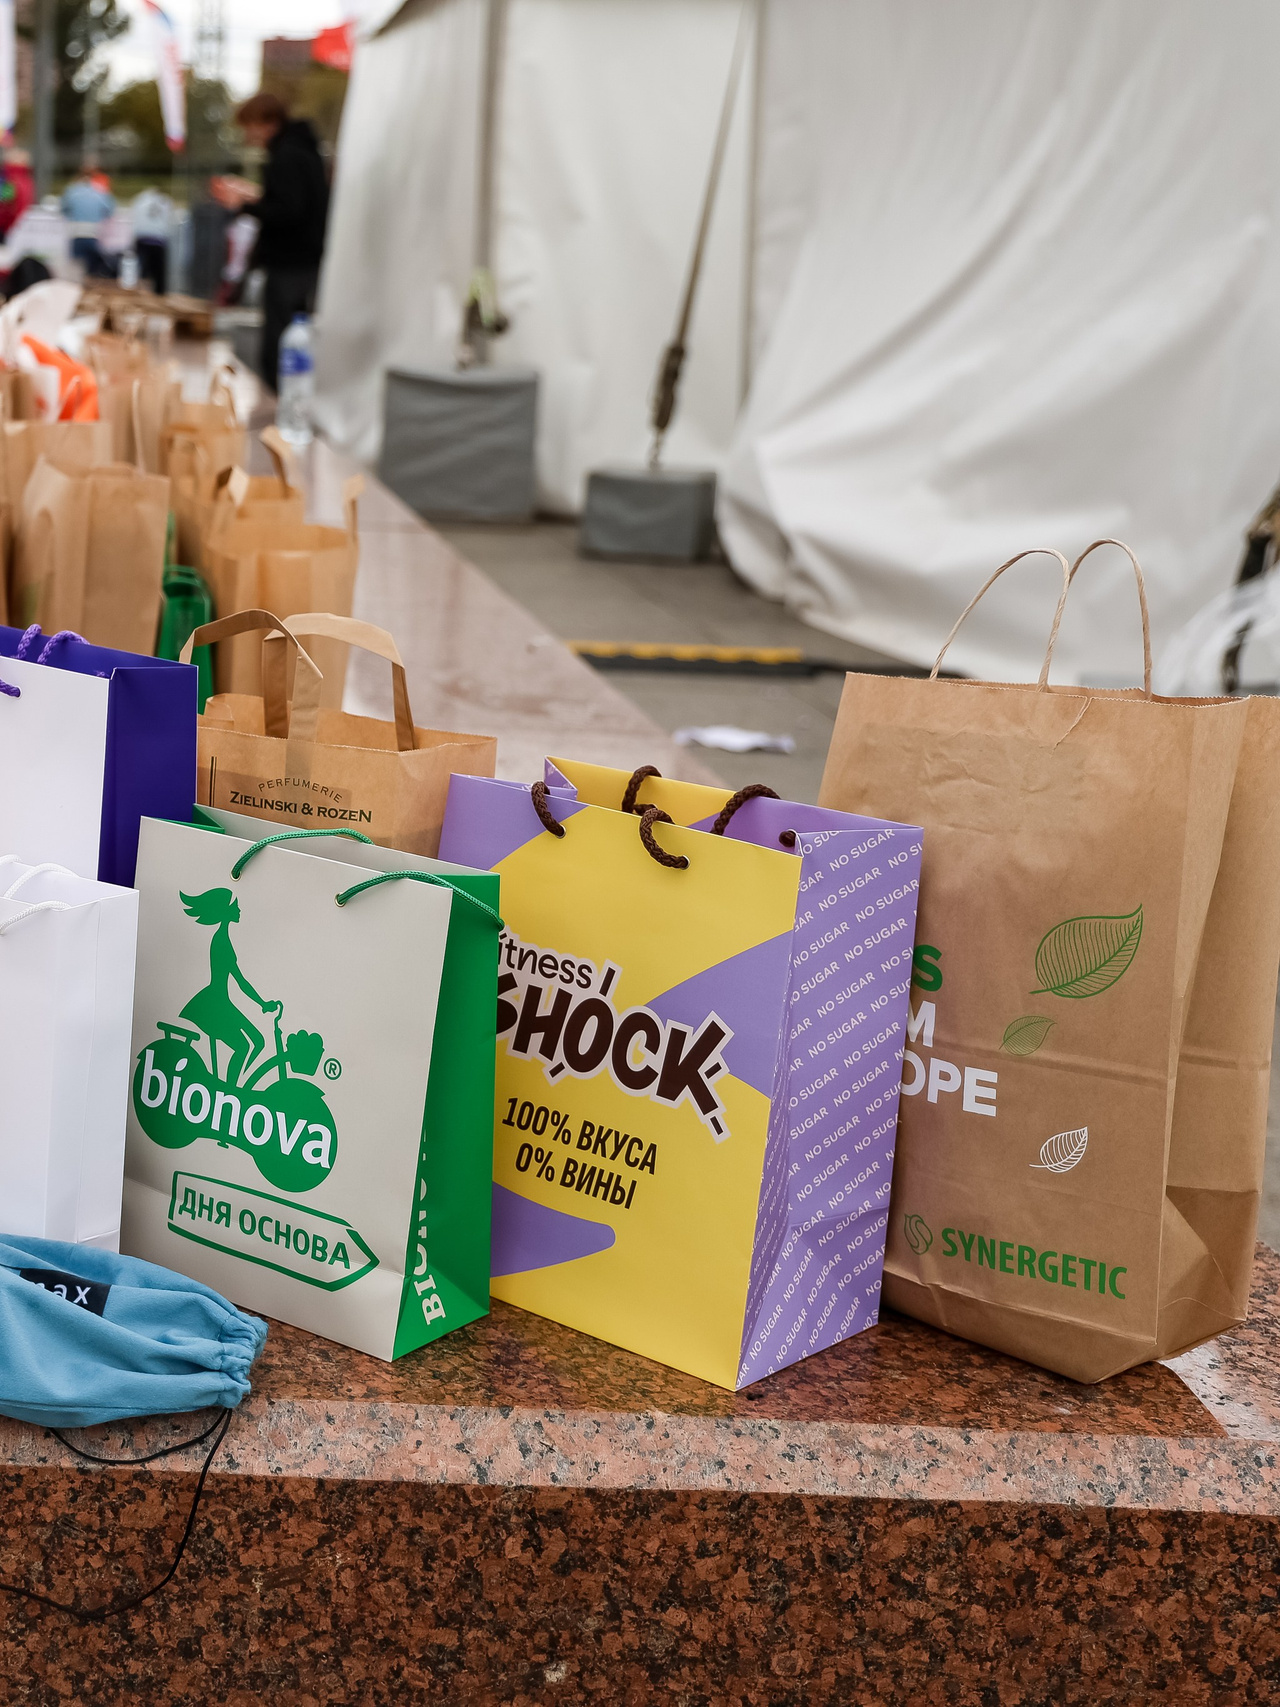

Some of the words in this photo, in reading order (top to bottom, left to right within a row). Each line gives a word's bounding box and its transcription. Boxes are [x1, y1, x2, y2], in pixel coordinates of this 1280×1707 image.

[229, 790, 297, 813] ZIELINSKI
[301, 802, 313, 815] &
[317, 806, 372, 823] ROZEN
[258, 777, 343, 803] PERFUMERIE
[818, 894, 837, 911] NO
[838, 867, 882, 898] SUGAR
[888, 852, 908, 868] NO
[829, 855, 849, 871] NO
[850, 829, 895, 859] SUGAR
[793, 950, 809, 968] NO
[810, 922, 850, 954] SUGAR
[855, 905, 875, 922] NO
[876, 879, 919, 910] SUGAR
[801, 961, 840, 994] SUGAR
[844, 945, 863, 962] NO
[864, 918, 908, 949] SUGAR
[817, 1000, 835, 1018] NO
[835, 972, 875, 1004] SUGAR
[880, 956, 900, 973] NO
[799, 1068, 839, 1100] SUGAR
[843, 1051, 861, 1068] NO
[862, 1022, 900, 1054] SUGAR
[808, 1040, 826, 1058] NO
[827, 1012, 867, 1044] SUGAR
[870, 995, 889, 1013] NO
[140, 1049, 333, 1169] bionova
[502, 1097, 571, 1145] 100%
[576, 1120, 658, 1175] ВКУСА
[790, 1107, 829, 1140] SUGAR
[833, 1089, 851, 1107] NO
[851, 1060, 890, 1093] SUGAR
[804, 1145, 822, 1162] NO
[823, 1115, 861, 1148] SUGAR
[865, 1098, 883, 1115] NO
[515, 1142, 555, 1182] 0%
[560, 1157, 637, 1209] ВИНЫ
[796, 1184, 813, 1202] NO
[813, 1154, 850, 1187] SUGAR
[854, 1136, 871, 1154] NO
[178, 1187, 232, 1228] ДНЯ
[238, 1209, 351, 1269] ОСНОВА
[781, 1241, 794, 1261] NO
[792, 1209, 826, 1244] SUGAR
[828, 1191, 845, 1209] NO
[845, 1161, 881, 1195] SUGAR
[749, 1340, 762, 1360] NO
[760, 1304, 784, 1343] SUGAR
[783, 1283, 795, 1303] NO
[793, 1248, 814, 1286] SUGAR
[818, 1230, 835, 1247] NO
[835, 1200, 873, 1233] SUGAR
[875, 1182, 891, 1200] NO
[775, 1344, 788, 1364] NO
[786, 1308, 808, 1346] SUGAR
[807, 1287, 818, 1306] NO
[816, 1253, 842, 1289] SUGAR
[846, 1236, 863, 1253] NO
[941, 1227, 1128, 1300] SYNERGETIC
[808, 1328, 819, 1348] NO
[817, 1293, 839, 1330] SUGAR
[837, 1273, 852, 1291] NO
[840, 1297, 861, 1334] SUGAR
[865, 1280, 882, 1297] NO
